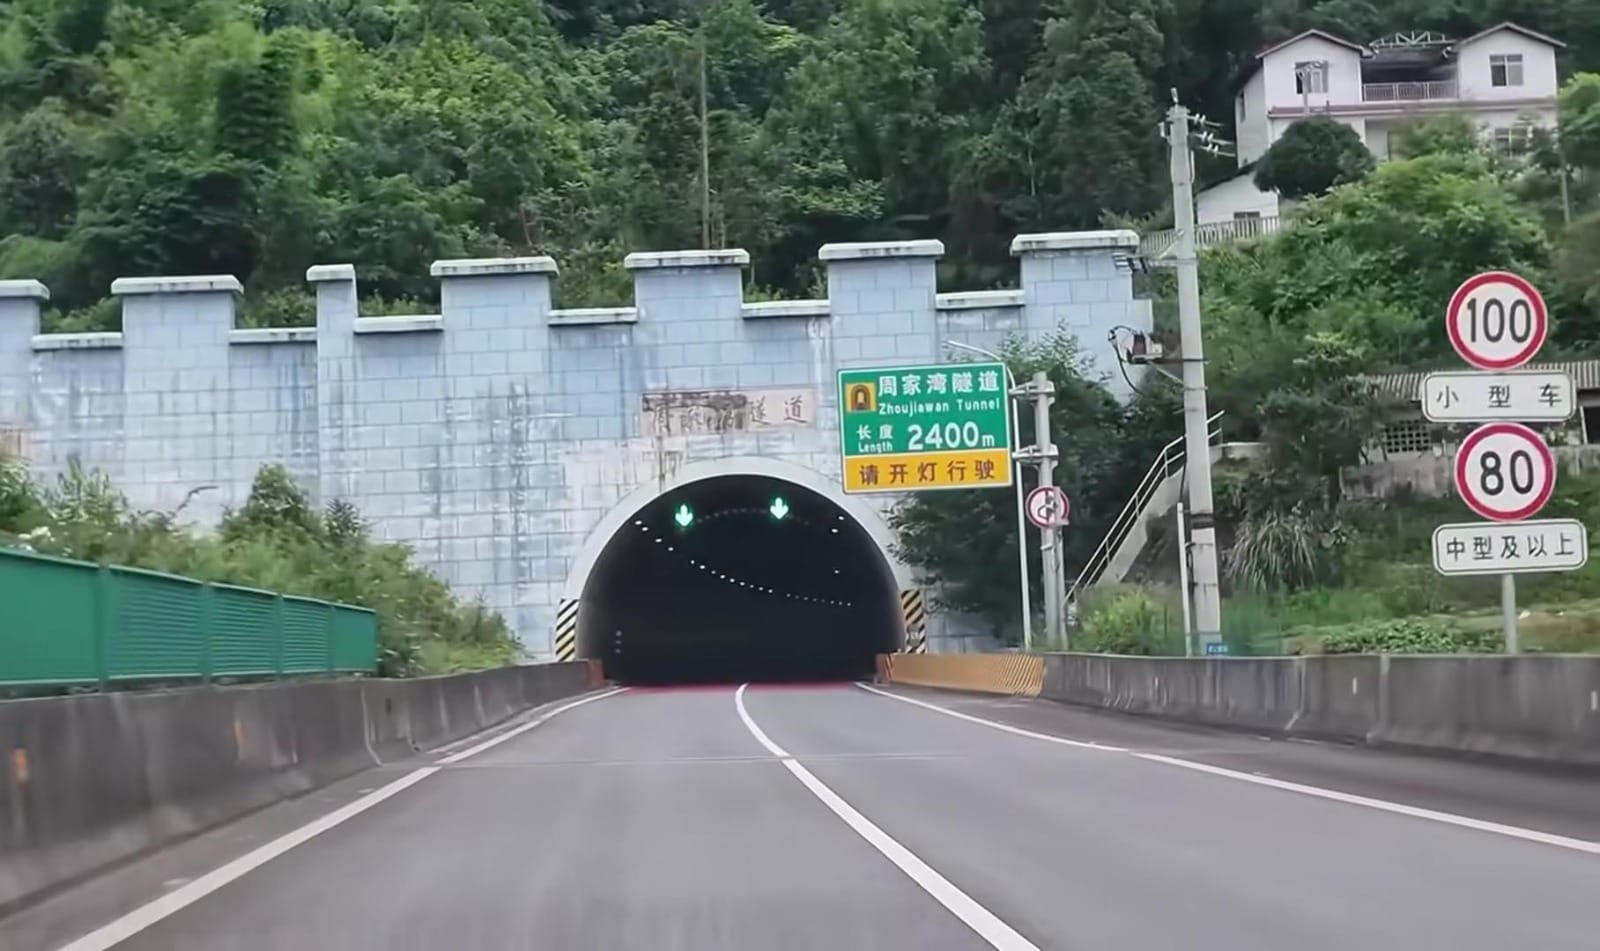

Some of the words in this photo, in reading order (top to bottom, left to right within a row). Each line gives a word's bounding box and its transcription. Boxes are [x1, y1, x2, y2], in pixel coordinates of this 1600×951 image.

[1467, 298, 1531, 343] 100
[878, 370, 999, 397] 周家湾隧道
[1436, 384, 1562, 409] 小型车
[878, 401, 949, 417] Zhoujiawan
[956, 398, 1000, 411] Tunnel
[856, 424, 893, 440] 长度
[858, 440, 893, 454] Length
[860, 459, 995, 486] 请开灯行驶
[1480, 450, 1534, 496] 80
[1447, 532, 1574, 562] 中型及以上
